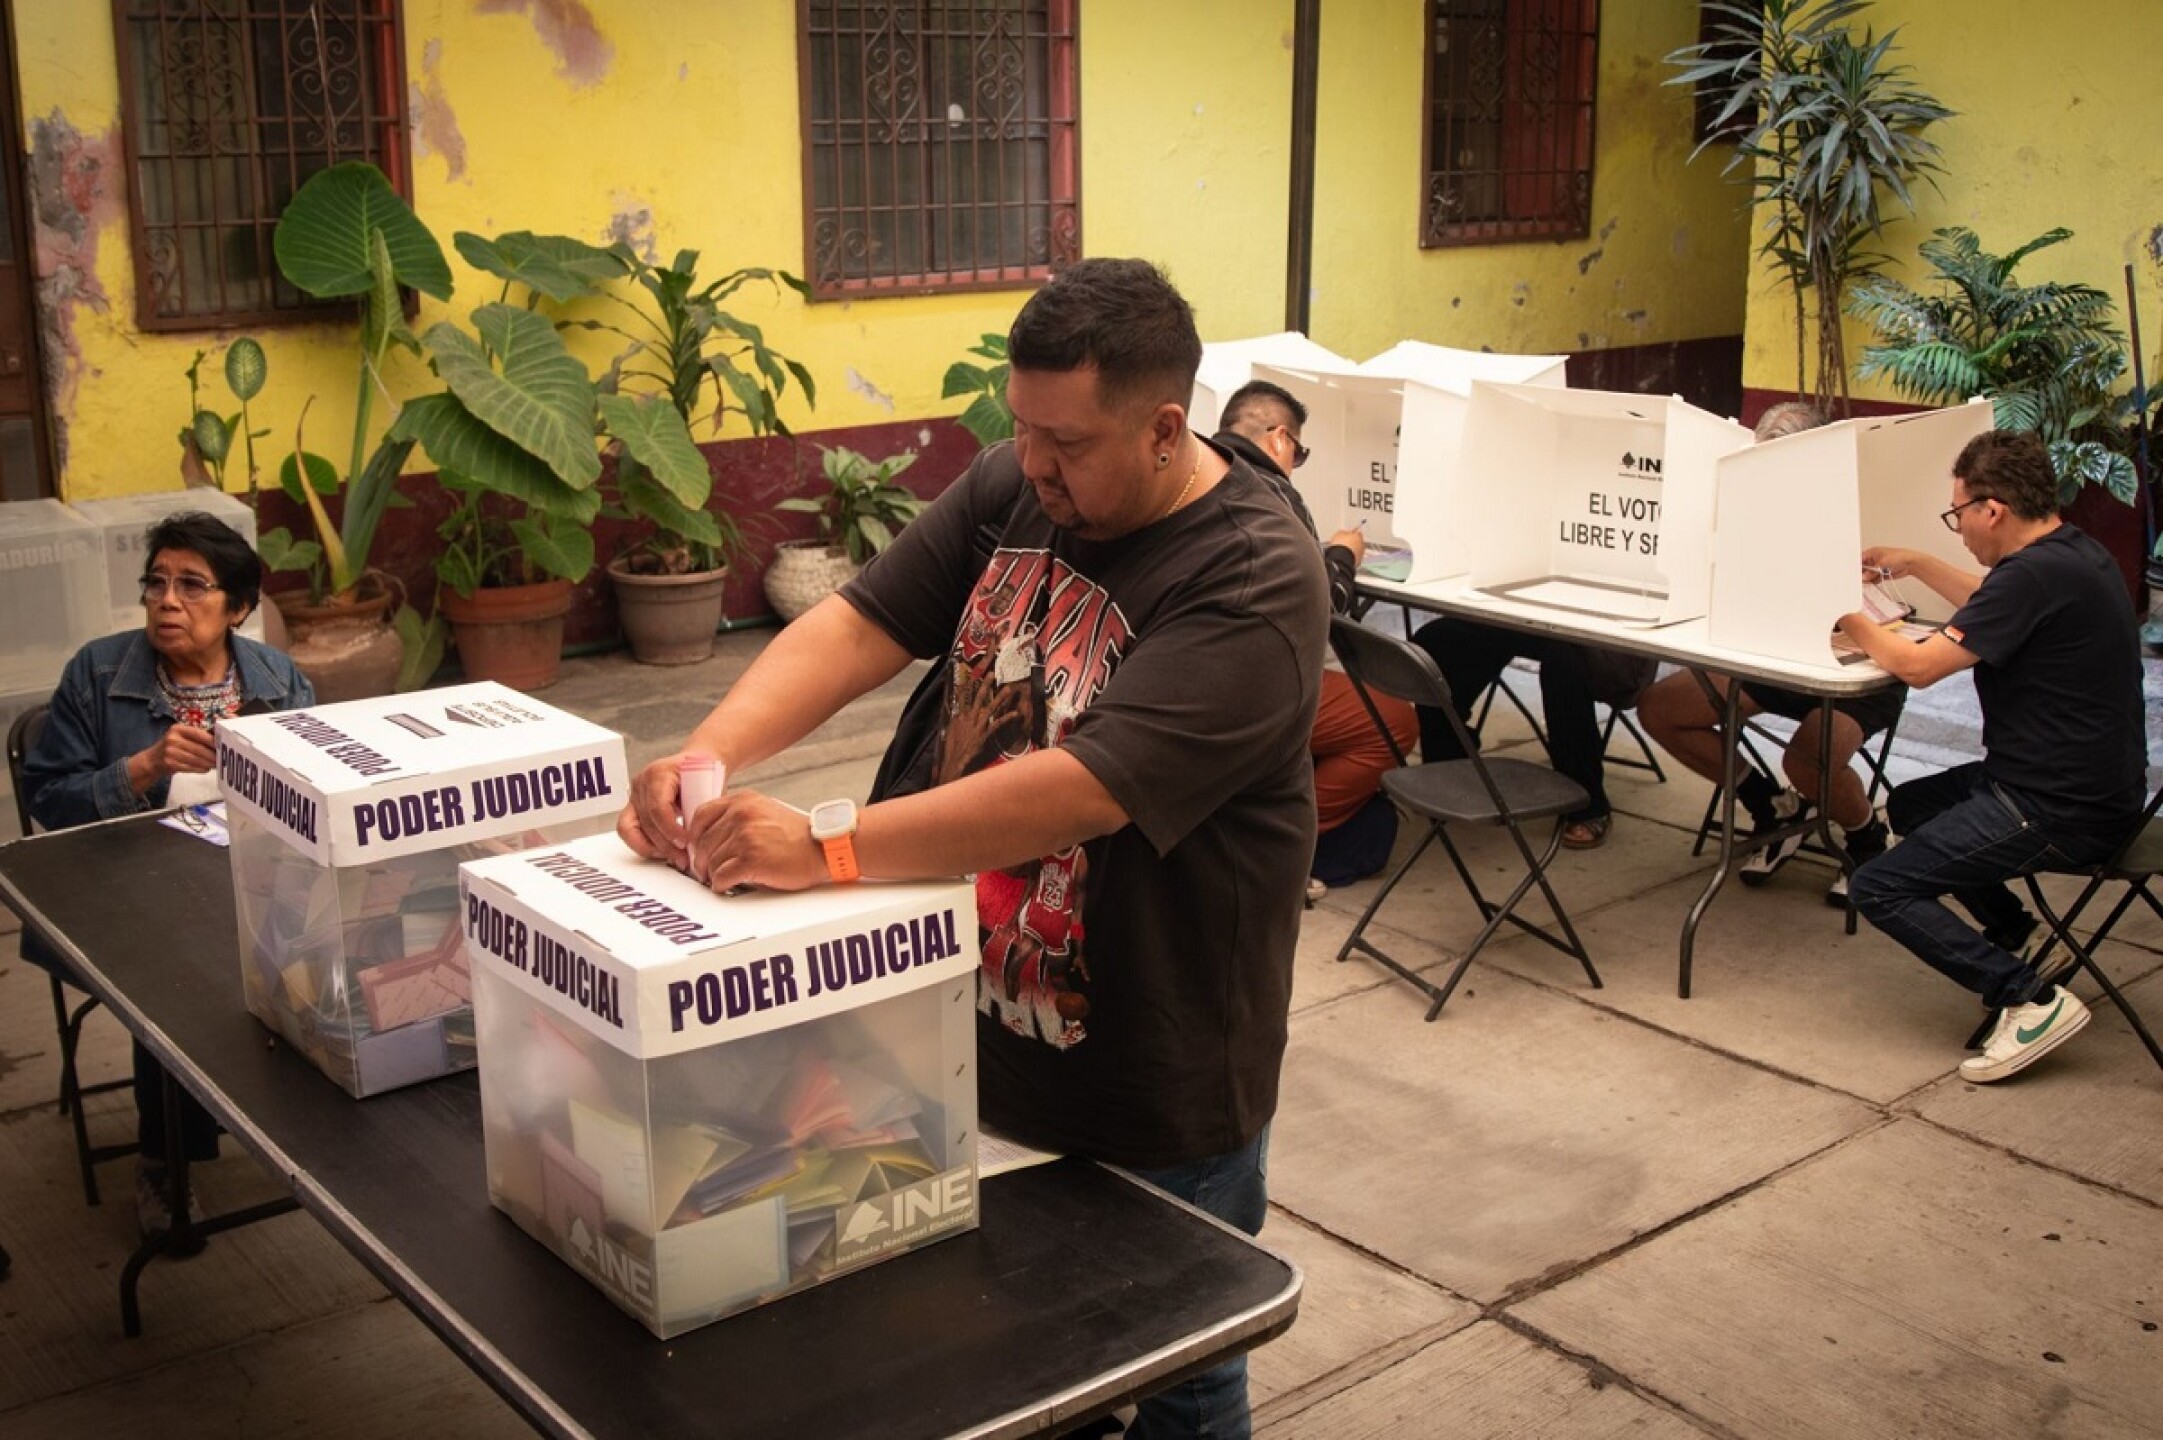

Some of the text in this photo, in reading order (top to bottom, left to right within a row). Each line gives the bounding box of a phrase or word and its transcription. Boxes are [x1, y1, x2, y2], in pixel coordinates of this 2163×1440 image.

[1348, 487, 1393, 514] LIBRE
[1371, 461, 1390, 484] EL
[1589, 492, 1661, 521] EL VOT
[1560, 520, 1615, 549] LIBRE
[1622, 529, 1634, 552] Y
[270, 711, 402, 776] PODER JUDICIAL
[220, 742, 318, 844] PODER JUDICIAL
[353, 756, 612, 847] PODER JUDICIAL
[525, 851, 720, 945] PODER JUDICIAL
[468, 892, 624, 1029] PODER JUDICIAL
[667, 953, 799, 1033] PODER
[805, 908, 962, 998] JUDICIAL
[893, 1167, 973, 1232] INE
[597, 1235, 654, 1308] INE
